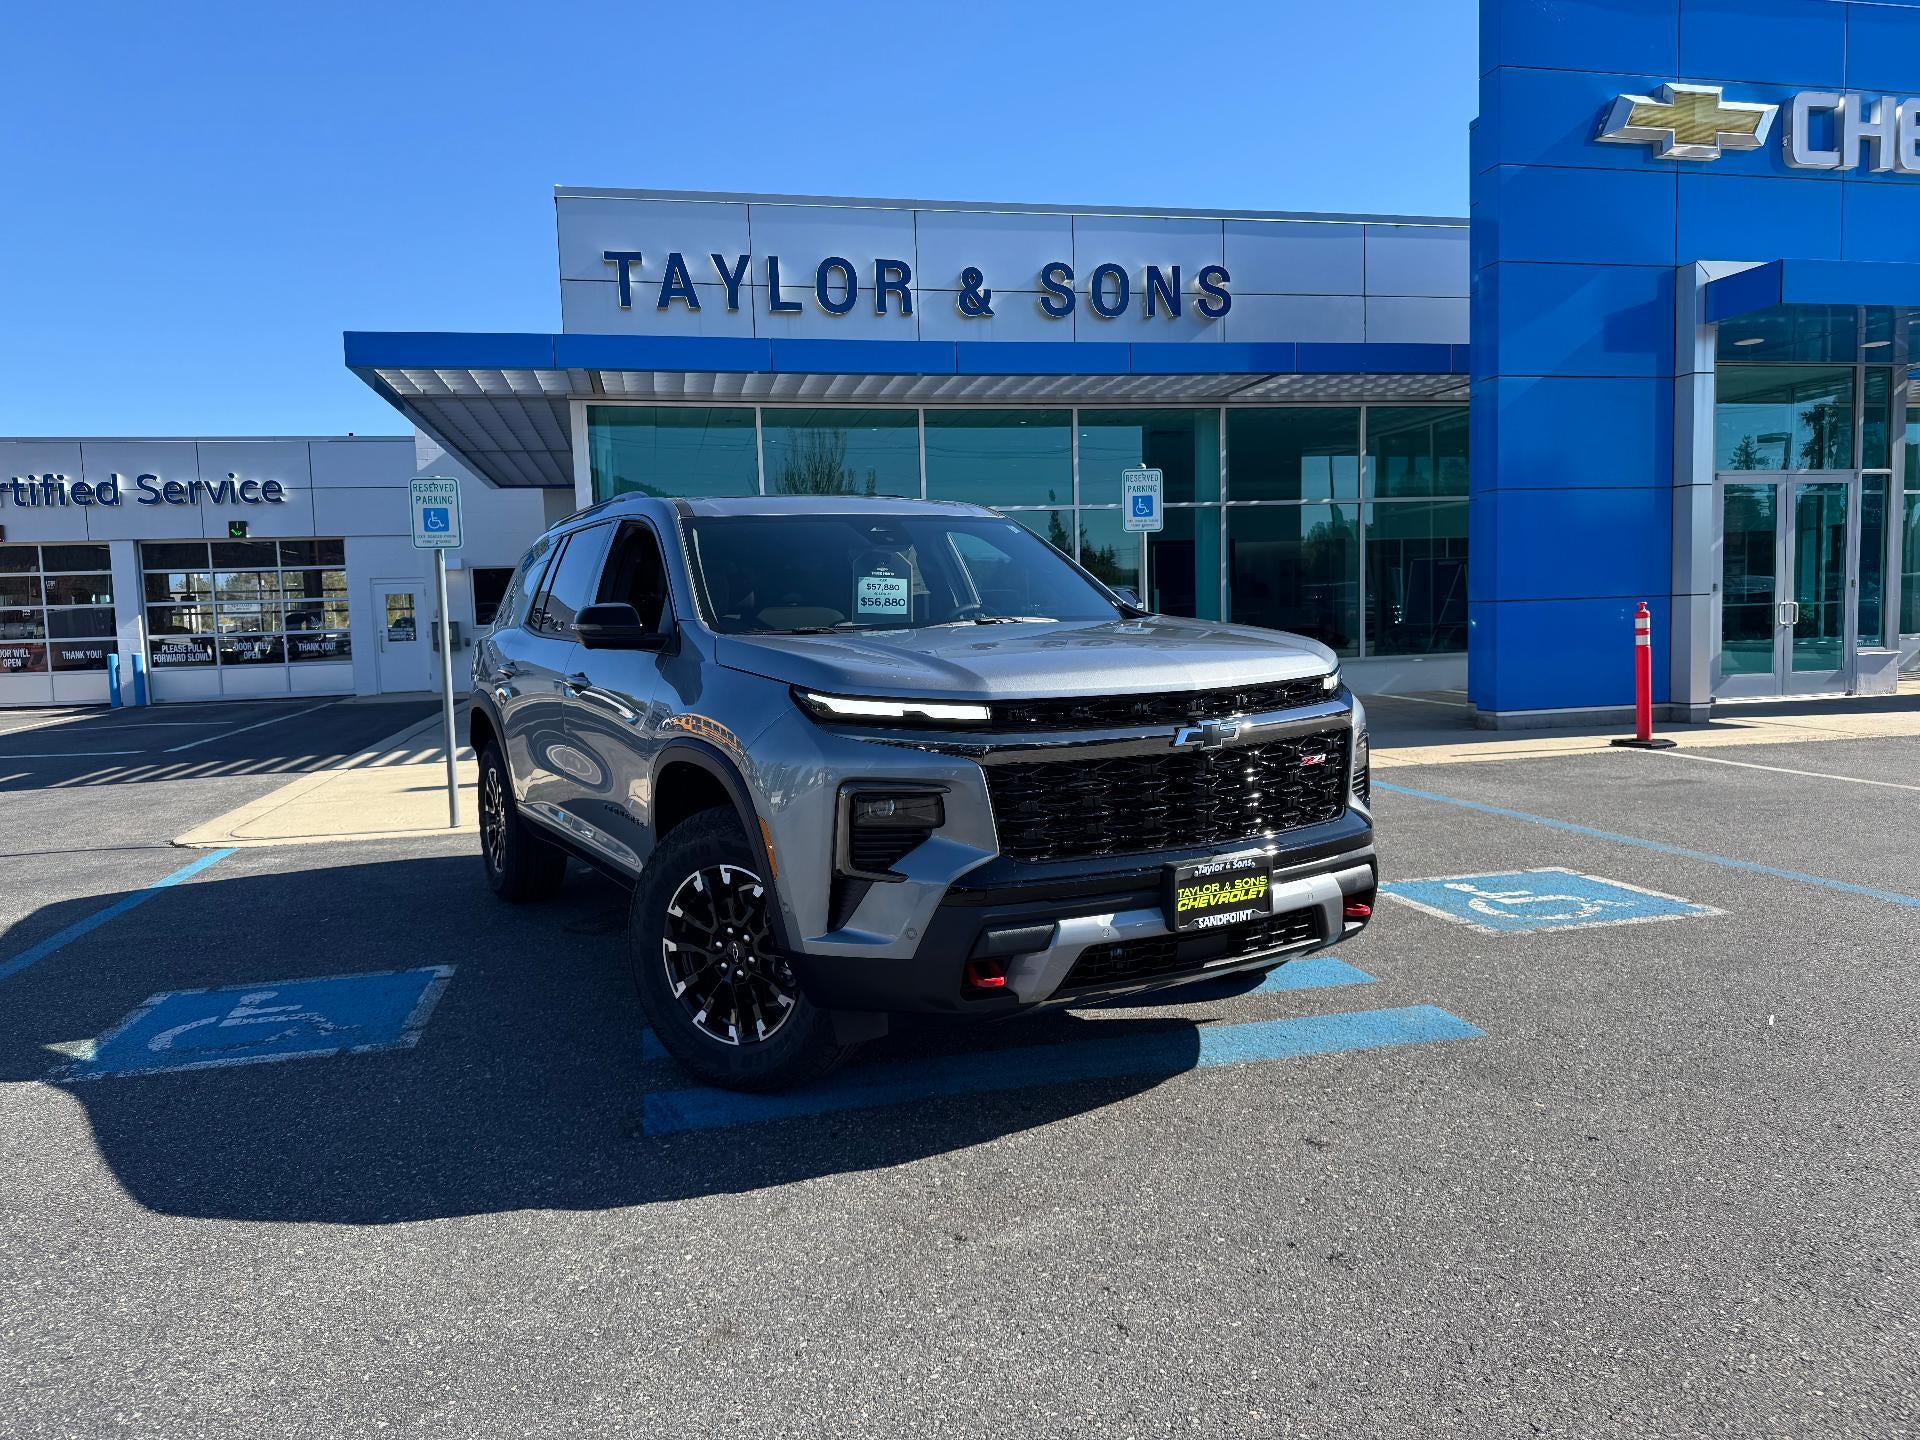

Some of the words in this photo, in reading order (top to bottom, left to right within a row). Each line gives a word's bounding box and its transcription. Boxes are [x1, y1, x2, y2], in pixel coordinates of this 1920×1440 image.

[603, 251, 914, 314] TAYLOR
[957, 266, 994, 317] &
[1039, 261, 1232, 319] SONS
[1125, 474, 1159, 483] RESERVED
[135, 472, 286, 505] Service
[412, 483, 455, 493] RESERVED
[1127, 484, 1158, 493] PARKING
[415, 495, 453, 505] PARKING
[866, 583, 900, 591] $57,880
[860, 597, 906, 608] $56,880
[161, 644, 187, 653] PLEASE
[188, 643, 205, 652] PULL
[233, 642, 252, 651] DOOR
[298, 642, 319, 651] THANK
[320, 642, 336, 650] YOU!
[13, 648, 30, 657] WILL
[61, 650, 85, 659] THANK
[86, 649, 103, 659] YOU!
[153, 653, 186, 662] FORWARD
[243, 651, 260, 660] OPEN
[3, 658, 21, 667] OPEN
[1197, 862, 1224, 876] Taylor
[1177, 883, 1220, 898] TAYLOR
[1223, 882, 1231, 892] &
[1234, 876, 1268, 889] SONS
[1177, 887, 1268, 911] CHEVROLET
[1197, 910, 1253, 928] SANDPOINT
